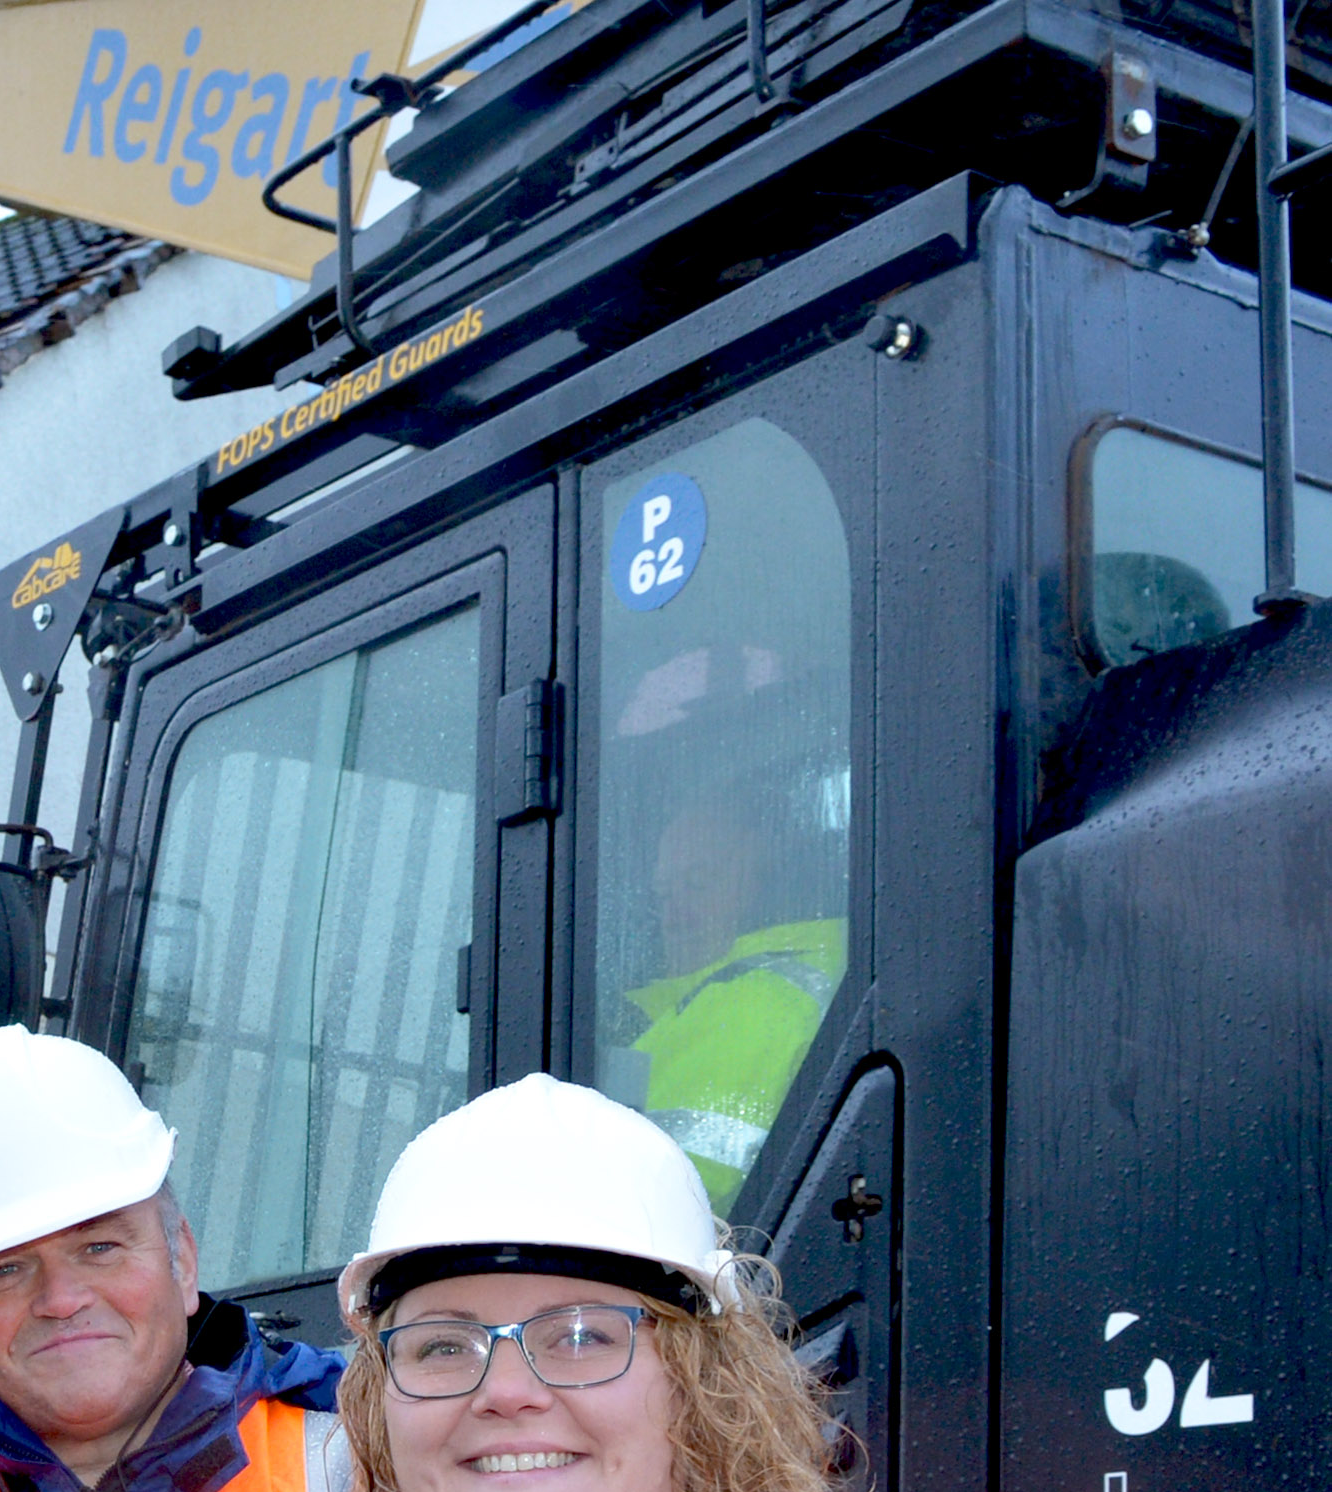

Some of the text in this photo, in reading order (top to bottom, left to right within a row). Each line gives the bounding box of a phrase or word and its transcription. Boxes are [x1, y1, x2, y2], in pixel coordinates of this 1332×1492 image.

[63, 26, 371, 206] Reigart
[216, 306, 484, 474] FOPS Certified Guards
[629, 536, 684, 595] 62
[643, 494, 672, 544] P
